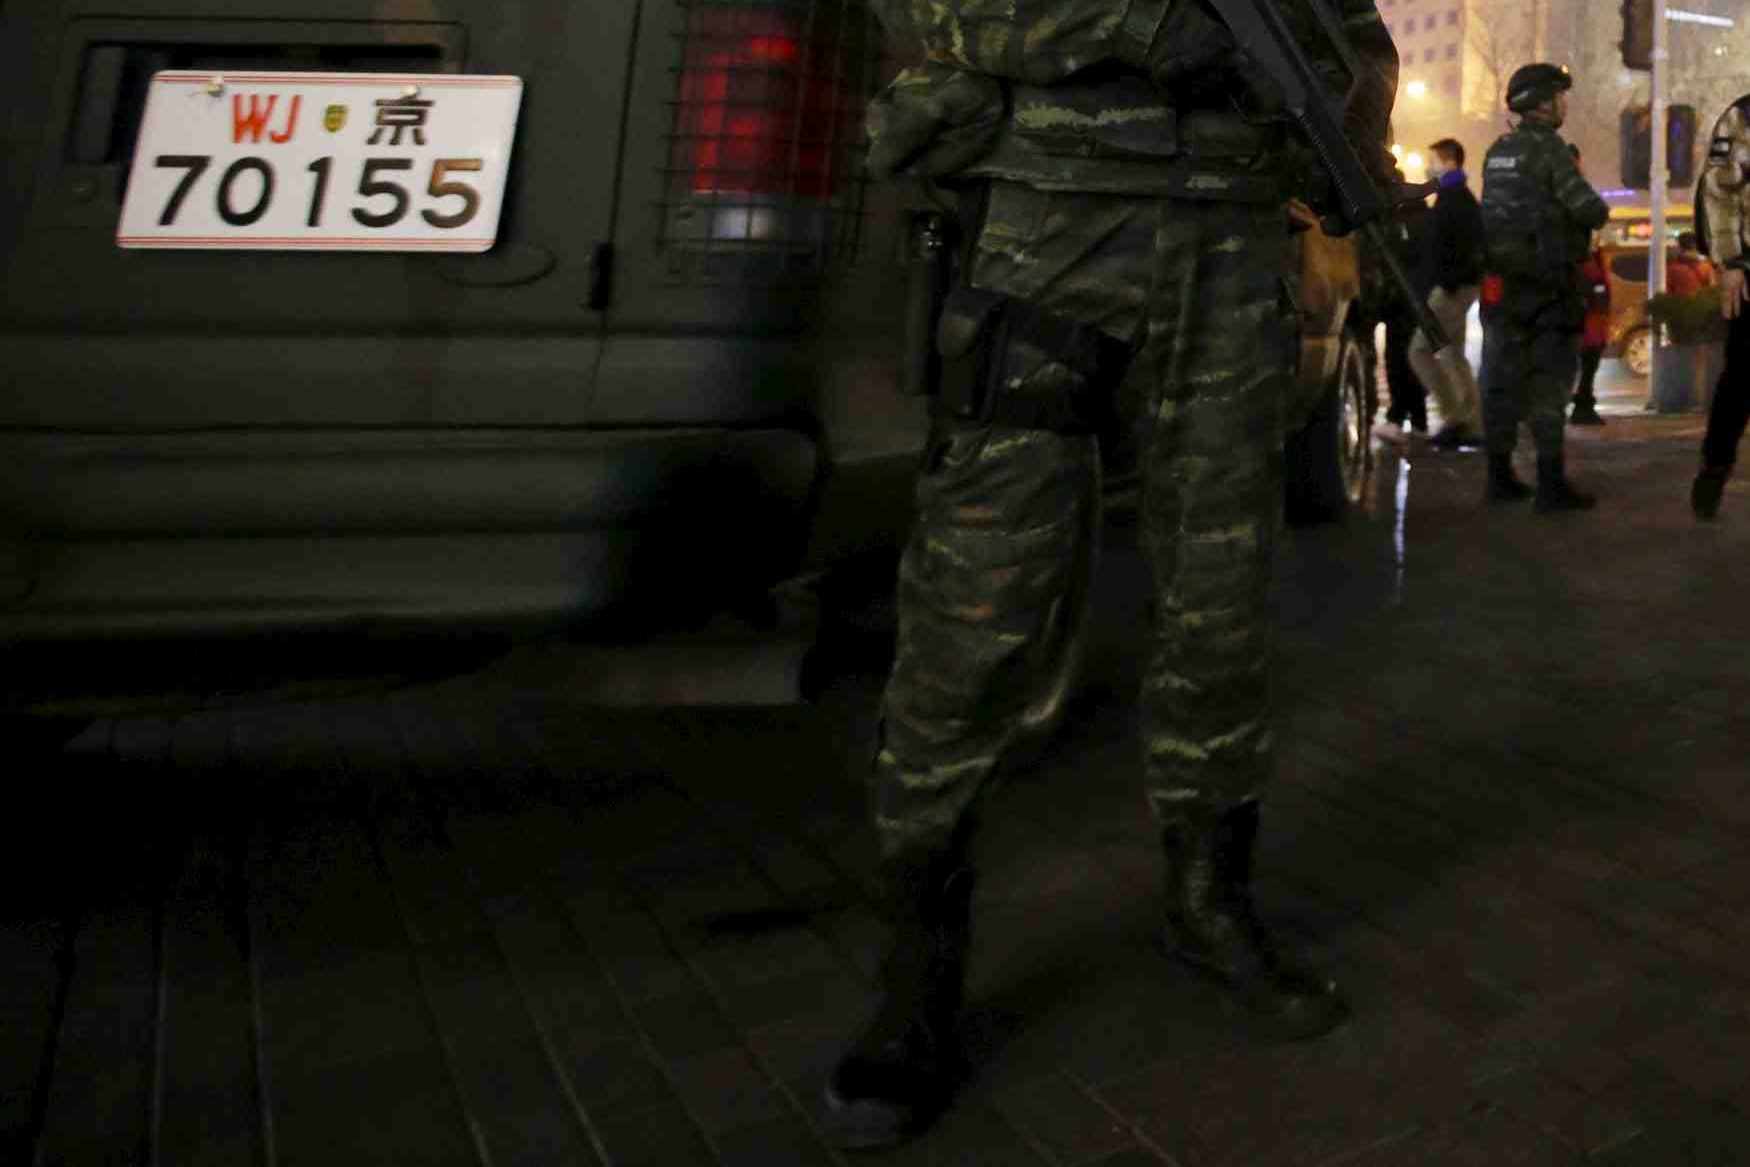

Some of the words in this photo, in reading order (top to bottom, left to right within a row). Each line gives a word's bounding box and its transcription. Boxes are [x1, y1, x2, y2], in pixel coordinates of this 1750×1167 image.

[231, 94, 303, 144] WJ
[366, 90, 434, 145] 京
[155, 154, 482, 229] 70155
